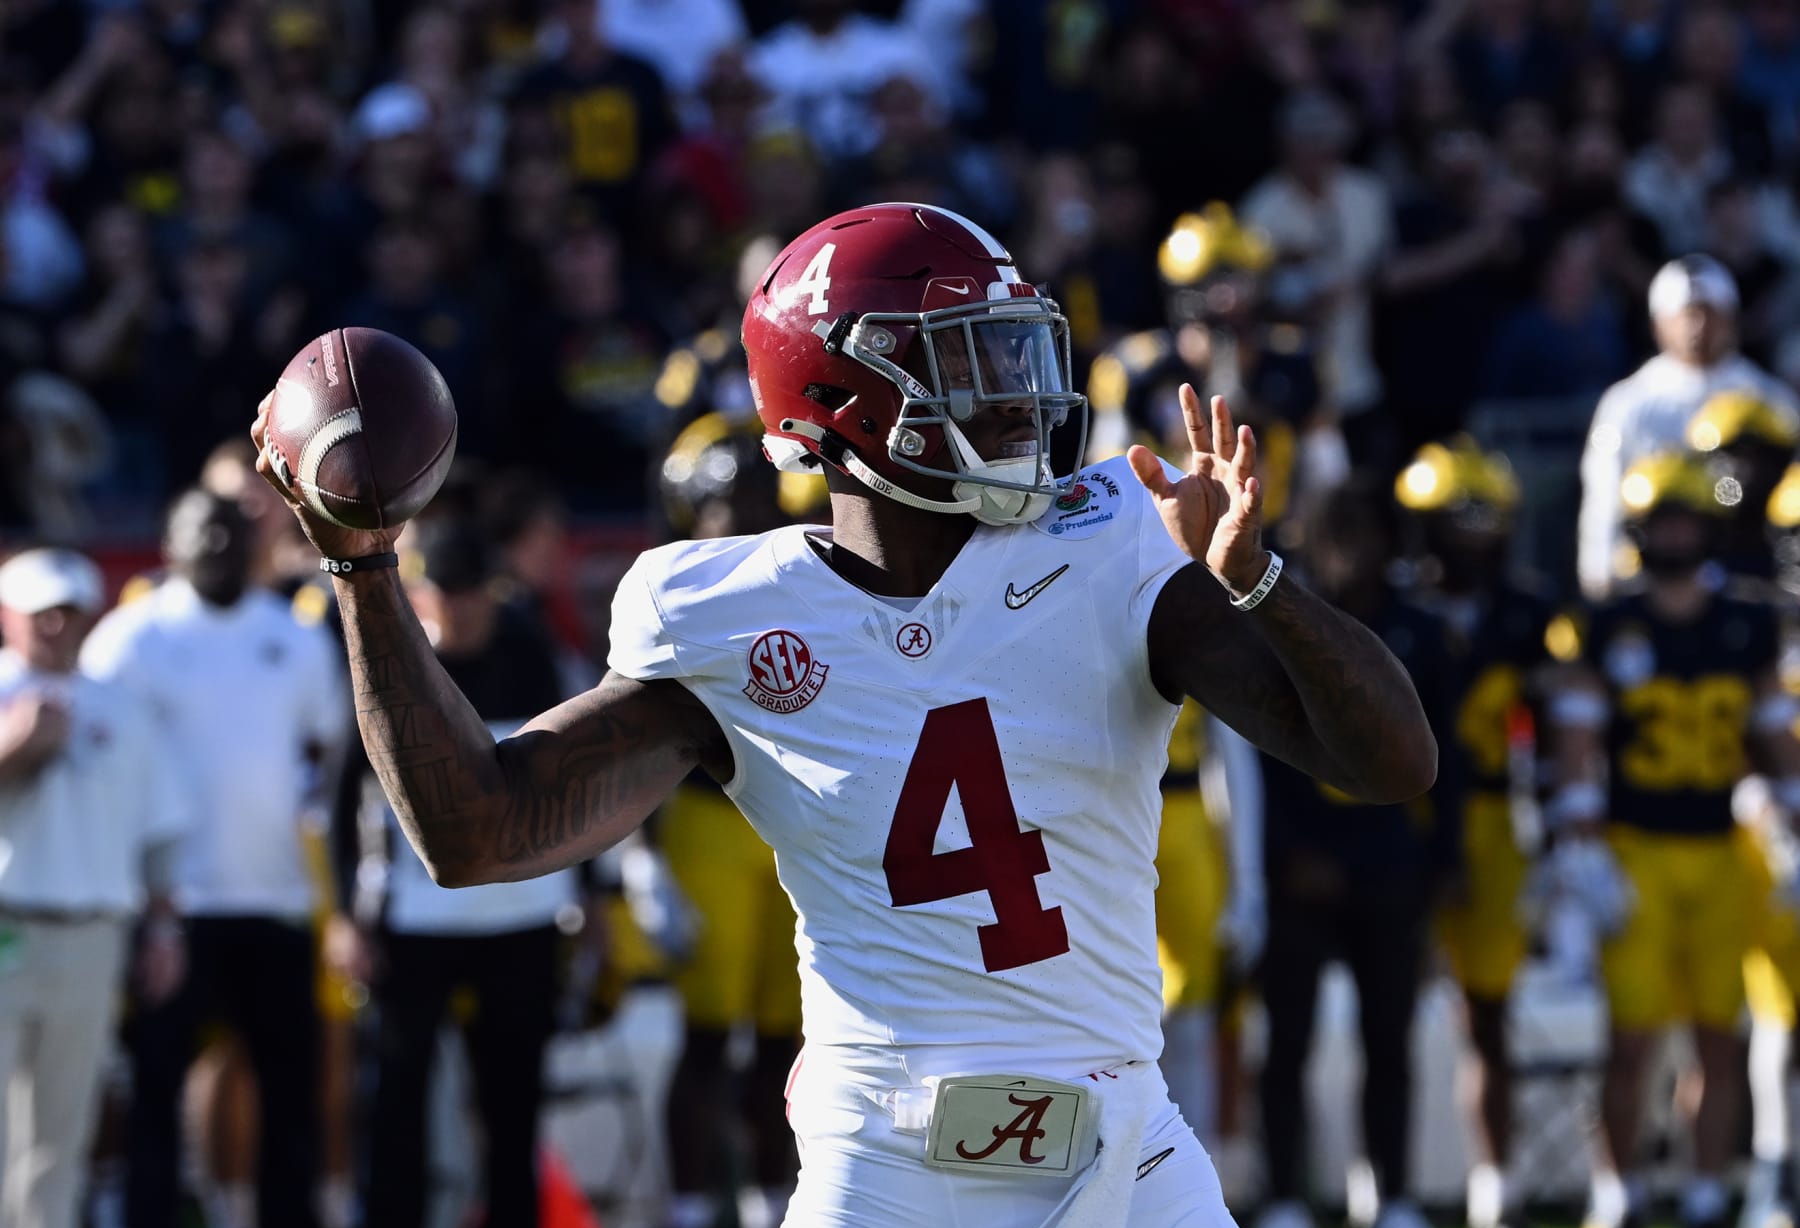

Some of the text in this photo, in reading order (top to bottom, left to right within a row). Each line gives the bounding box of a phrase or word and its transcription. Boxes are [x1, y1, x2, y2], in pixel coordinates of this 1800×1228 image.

[798, 243, 836, 315] 4
[912, 382, 934, 399] TID
[869, 472, 893, 495] TIDE
[1091, 473, 1119, 497] GAME
[1058, 507, 1089, 521] presented
[1065, 512, 1113, 530] Prudential
[1245, 563, 1280, 607] OVER HYPE
[903, 628, 925, 651] A
[752, 633, 804, 691] SEC
[757, 678, 819, 712] GRADUATE
[883, 697, 1070, 973] 4
[955, 1093, 1055, 1164] A
